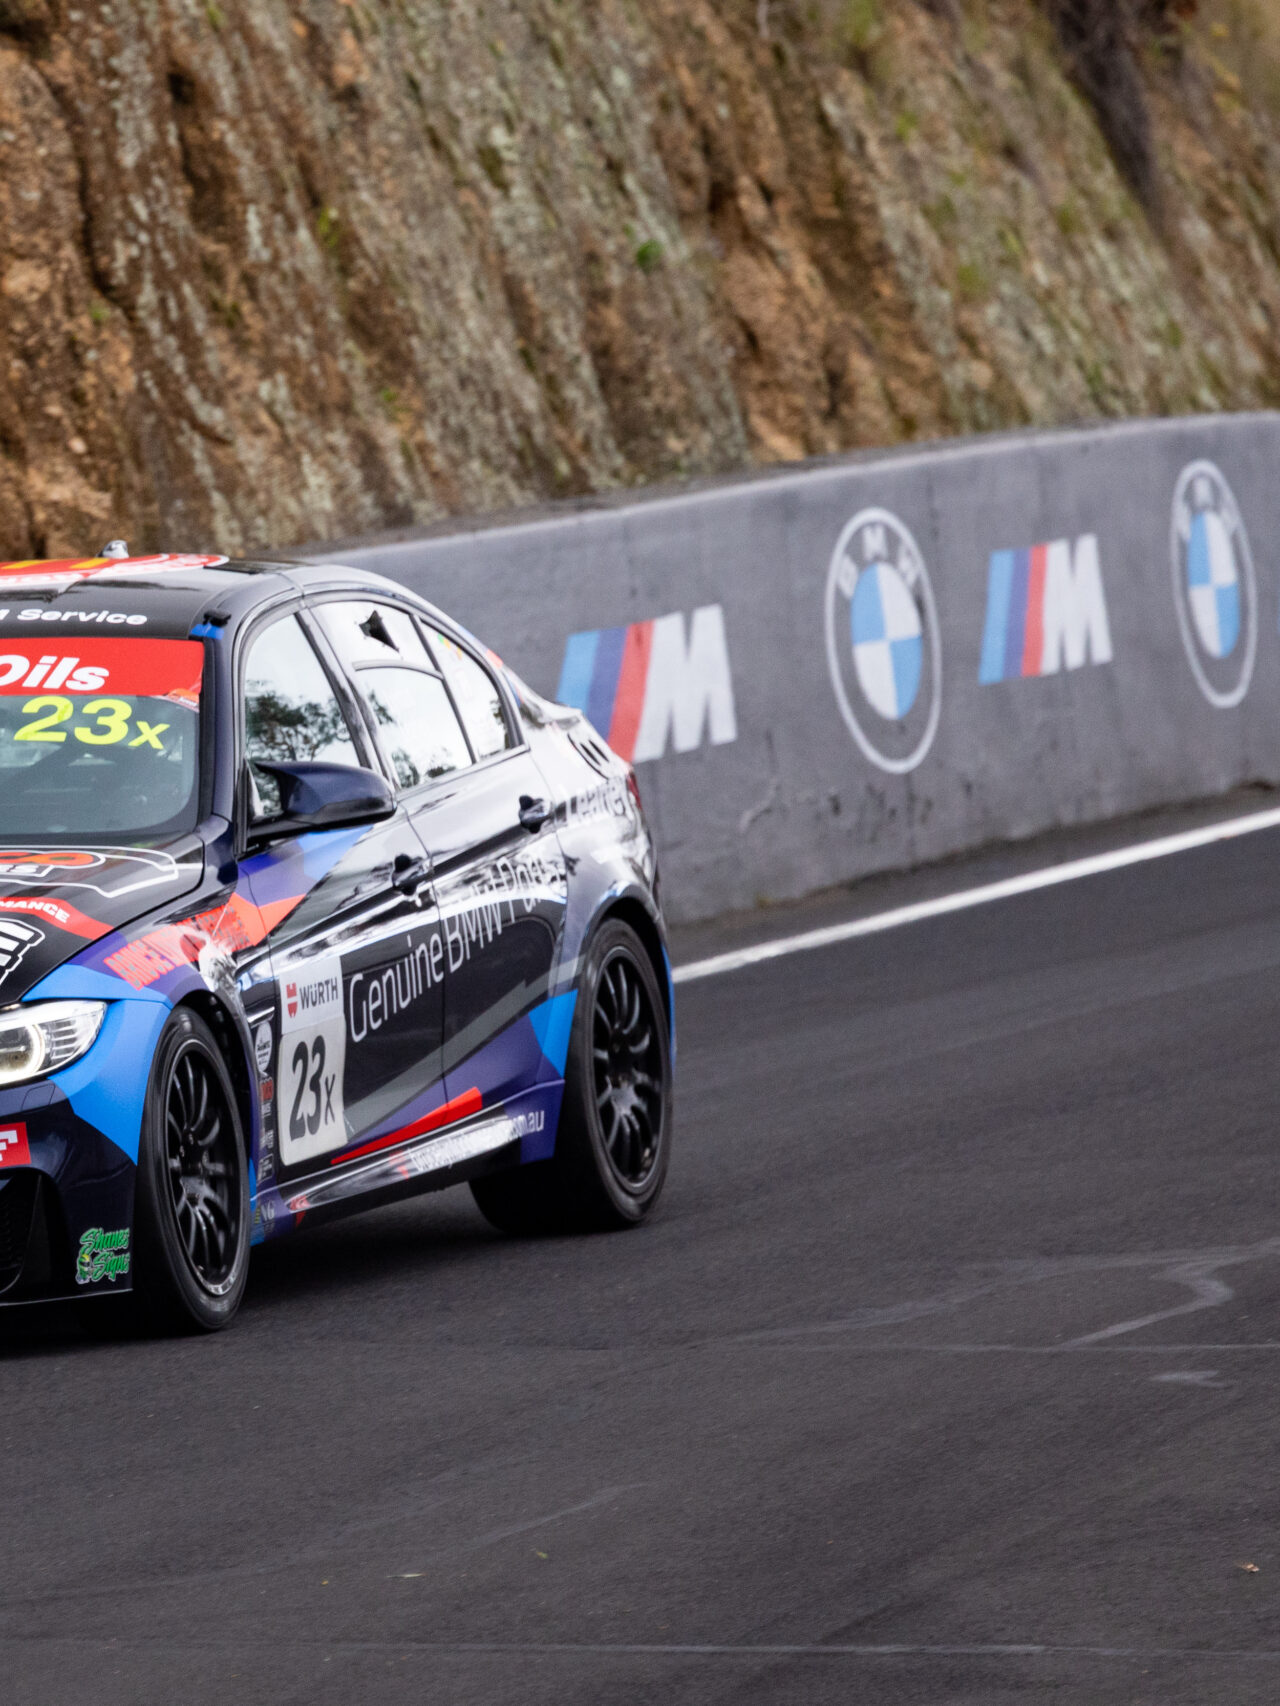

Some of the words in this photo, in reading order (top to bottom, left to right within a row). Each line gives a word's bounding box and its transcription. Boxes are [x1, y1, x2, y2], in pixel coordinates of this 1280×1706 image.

[17, 607, 149, 626] Service
[349, 934, 445, 1043] Genuine
[443, 872, 502, 974] BMW
